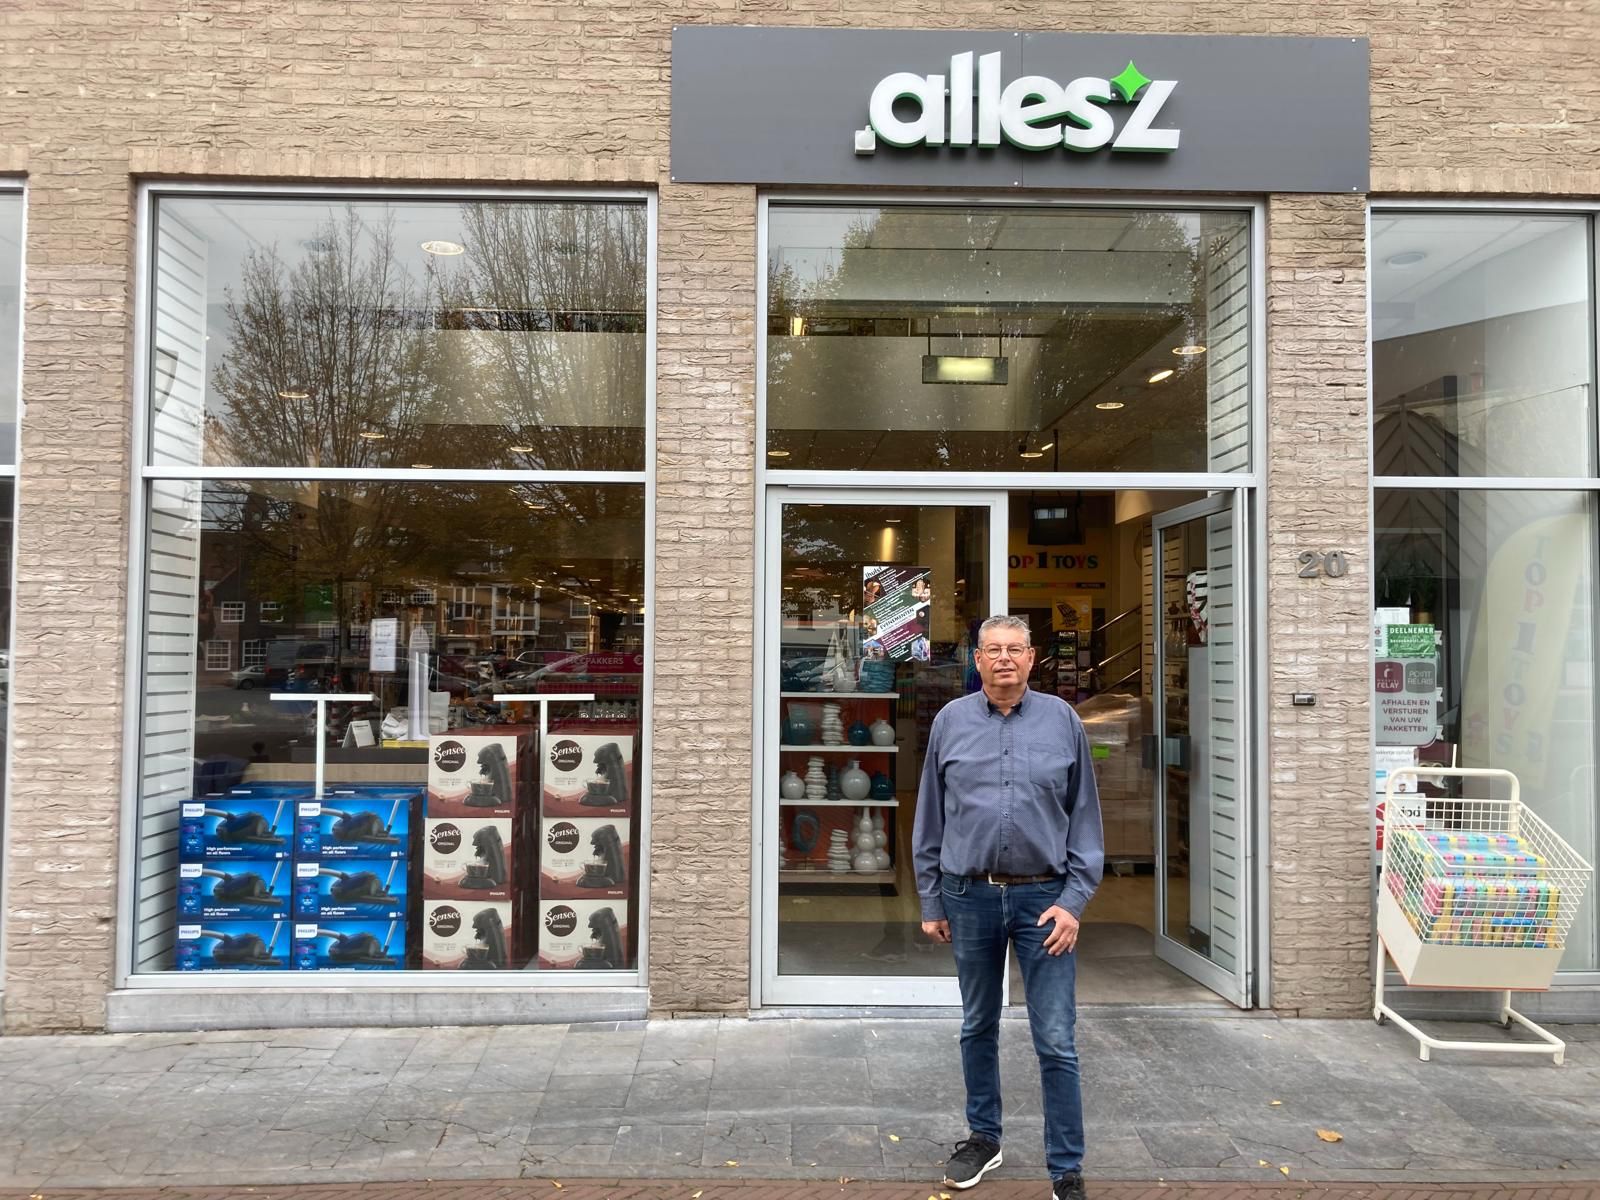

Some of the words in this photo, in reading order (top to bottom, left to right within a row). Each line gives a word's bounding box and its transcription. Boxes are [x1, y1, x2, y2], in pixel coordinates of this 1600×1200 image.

[1008, 556, 1034, 569] OP
[1052, 555, 1098, 569] TOYS
[1299, 551, 1345, 578] 20
